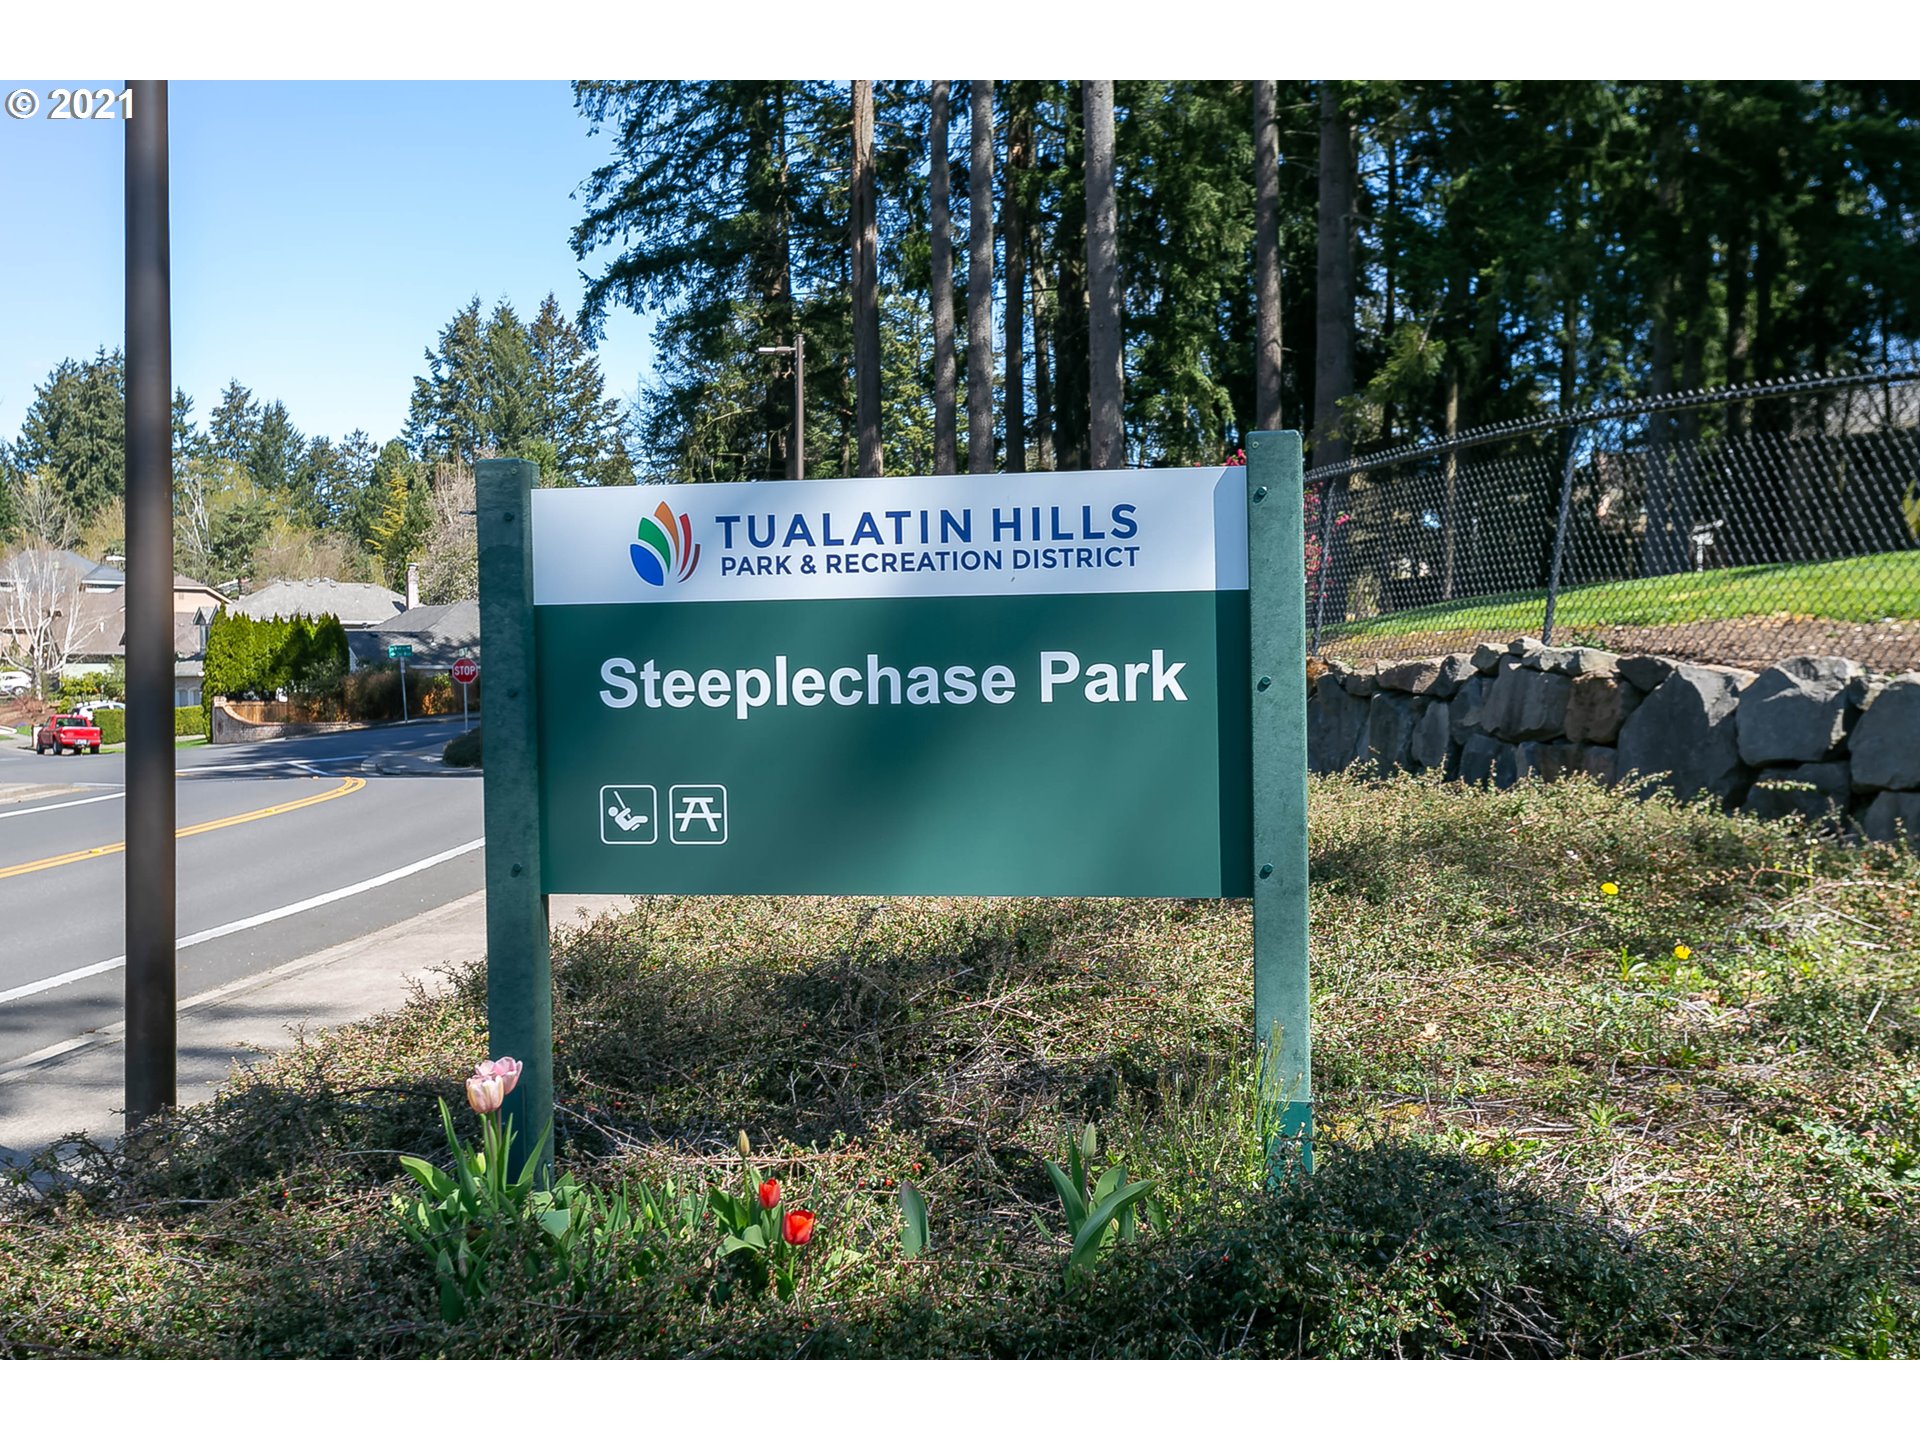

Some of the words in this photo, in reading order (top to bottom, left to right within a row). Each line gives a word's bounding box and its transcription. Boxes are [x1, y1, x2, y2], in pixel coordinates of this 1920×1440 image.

[715, 508, 972, 550] TUALATIN
[992, 504, 1138, 543] HILLS
[721, 555, 792, 577] PARK
[800, 554, 817, 575] &
[826, 550, 1002, 574] RECREATION
[1012, 546, 1141, 570] DISTRICT
[454, 666, 475, 676] STOP
[599, 655, 1016, 720] Steeplechase
[1040, 649, 1189, 703] Park
